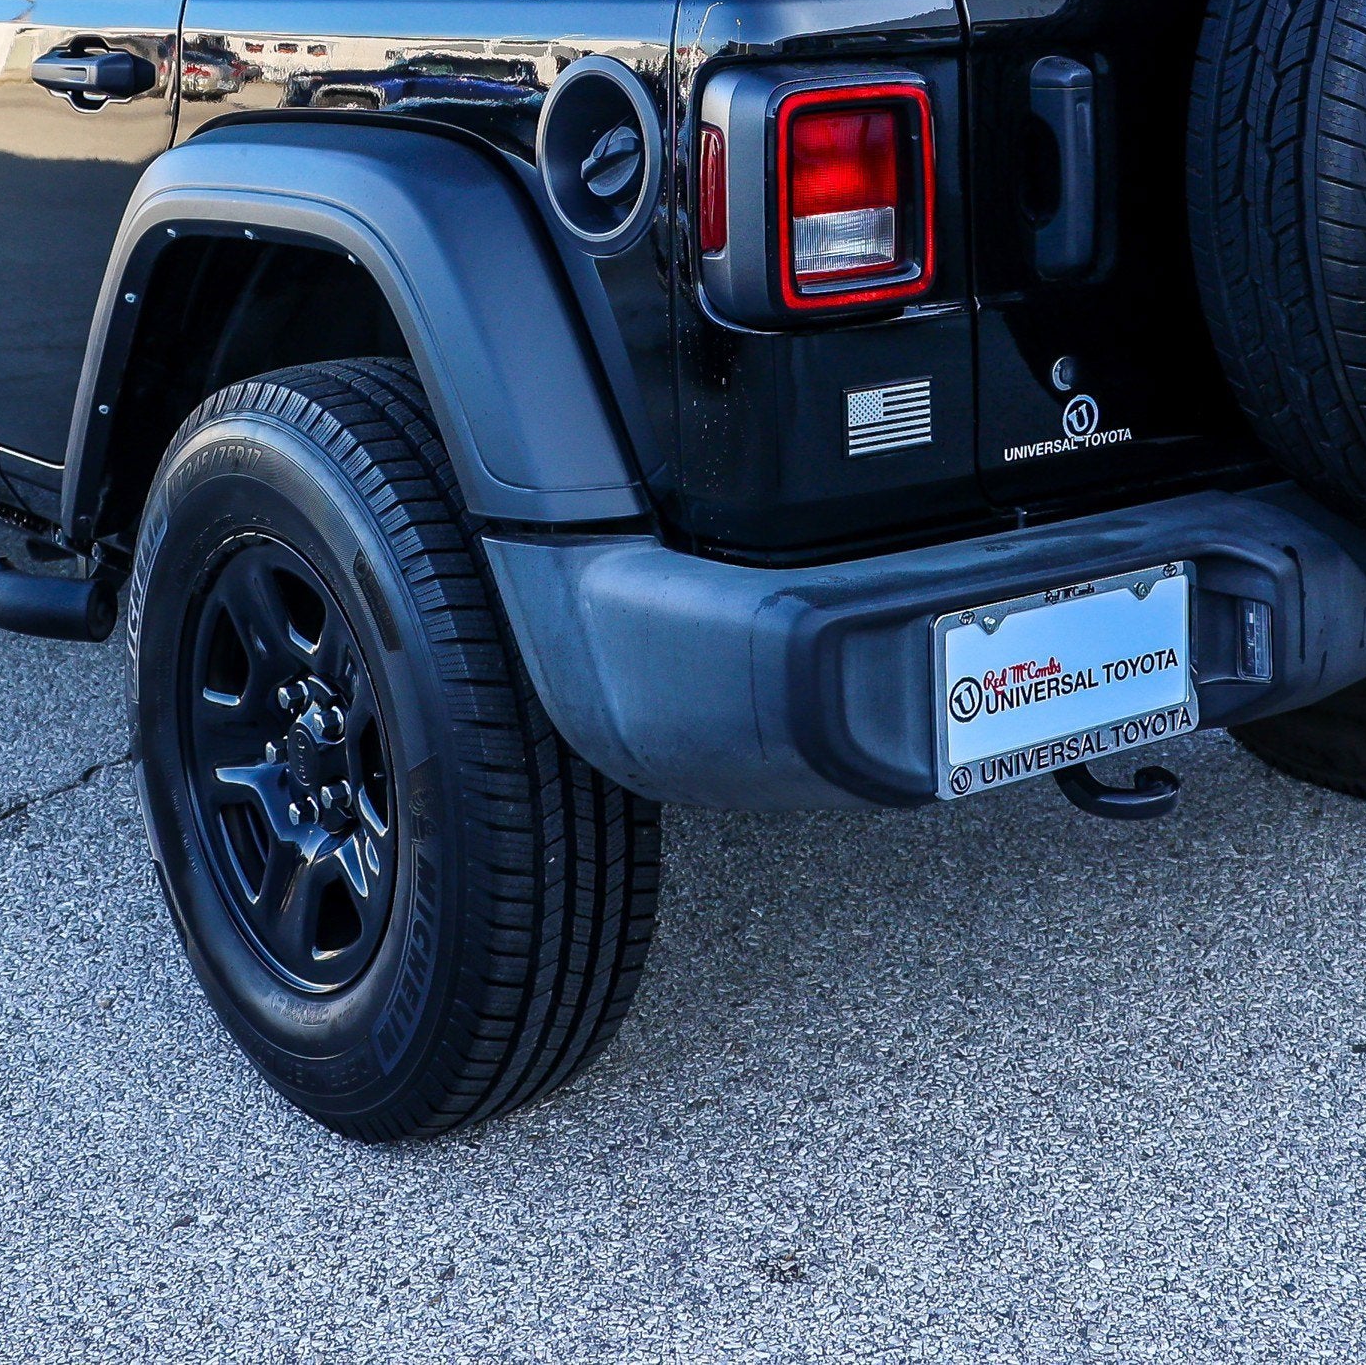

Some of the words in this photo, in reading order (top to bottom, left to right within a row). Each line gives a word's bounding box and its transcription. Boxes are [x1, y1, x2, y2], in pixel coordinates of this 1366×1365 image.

[1003, 438, 1078, 462] UNIVERSAL
[1083, 428, 1132, 448] TOYOTA
[983, 669, 1008, 695] Red
[1008, 657, 1062, 685] McCombs
[985, 667, 1098, 716] UNIVERSAL
[1102, 648, 1179, 686] TOYOTA
[979, 731, 1108, 784] UNIVERSAL
[1109, 707, 1193, 748] TOYOTA
